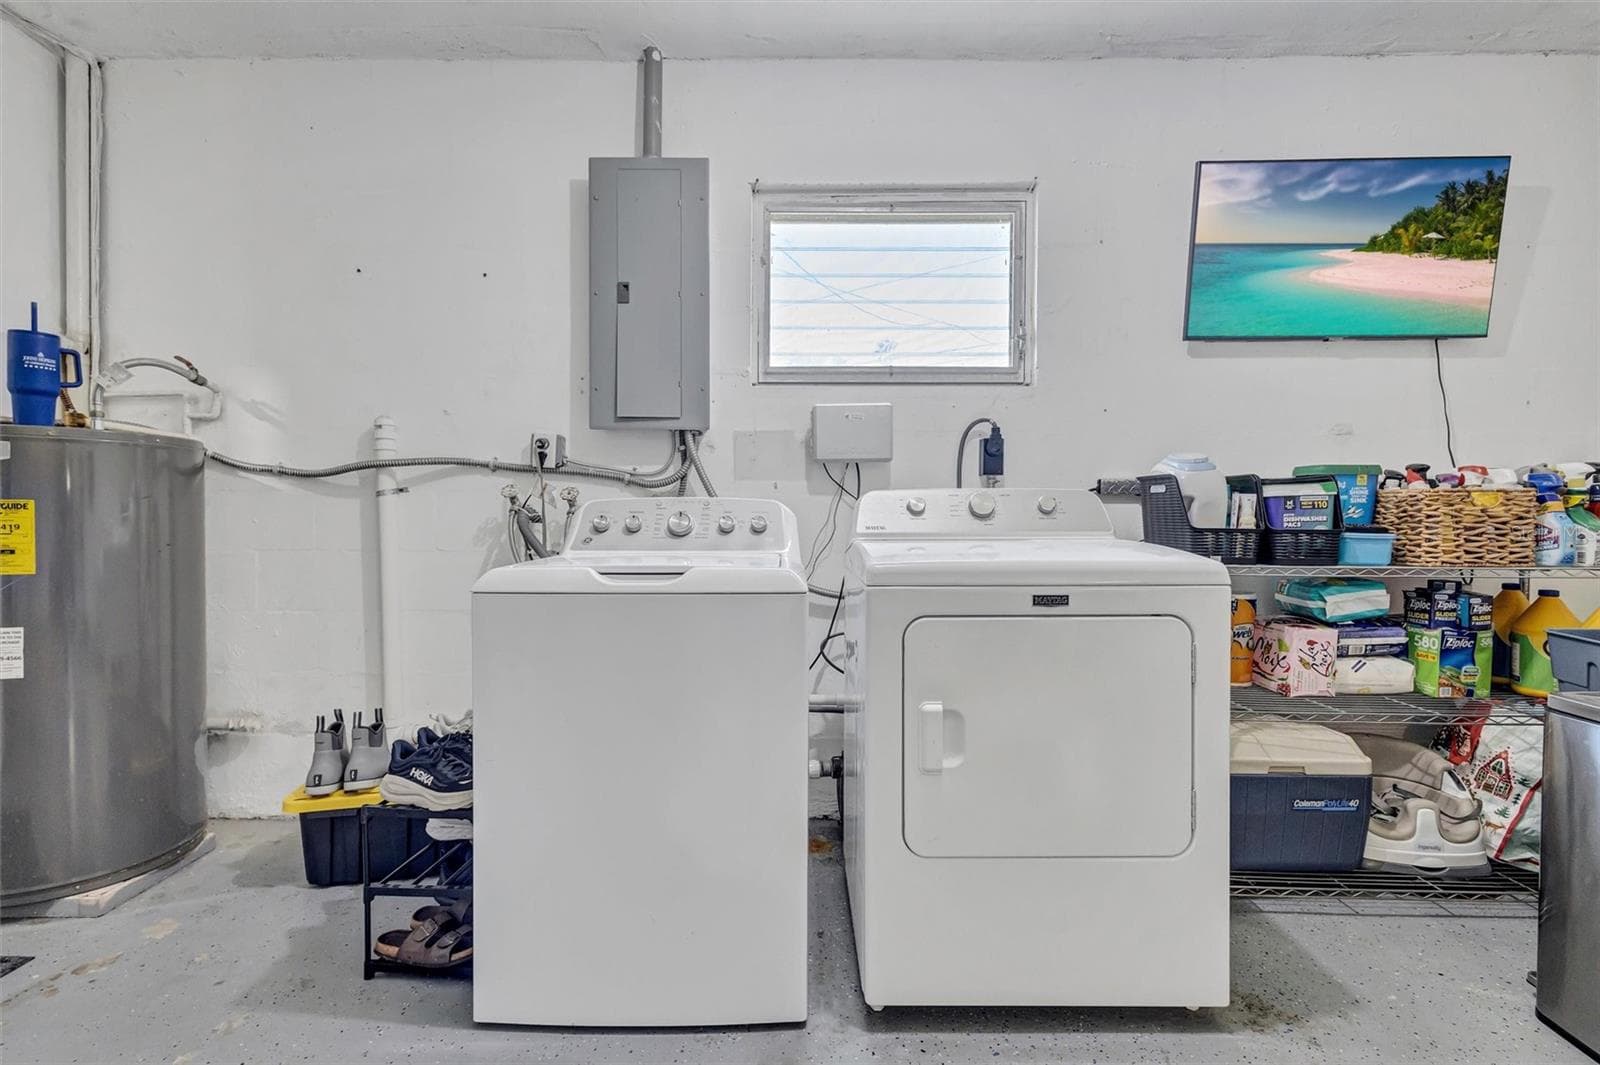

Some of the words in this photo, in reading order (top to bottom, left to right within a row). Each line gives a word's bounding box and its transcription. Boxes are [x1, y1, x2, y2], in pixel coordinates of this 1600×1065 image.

[1314, 500, 1328, 509] 110
[1283, 515, 1328, 523] DISHWASHER
[1034, 595, 1068, 604] MAYTAG
[1410, 599, 1431, 610] Ziploc
[1473, 604, 1493, 614] Ziploc
[1232, 626, 1252, 638] wels
[1413, 634, 1438, 649] 580
[1445, 637, 1474, 649] Ziploc
[410, 767, 433, 786] HOKA
